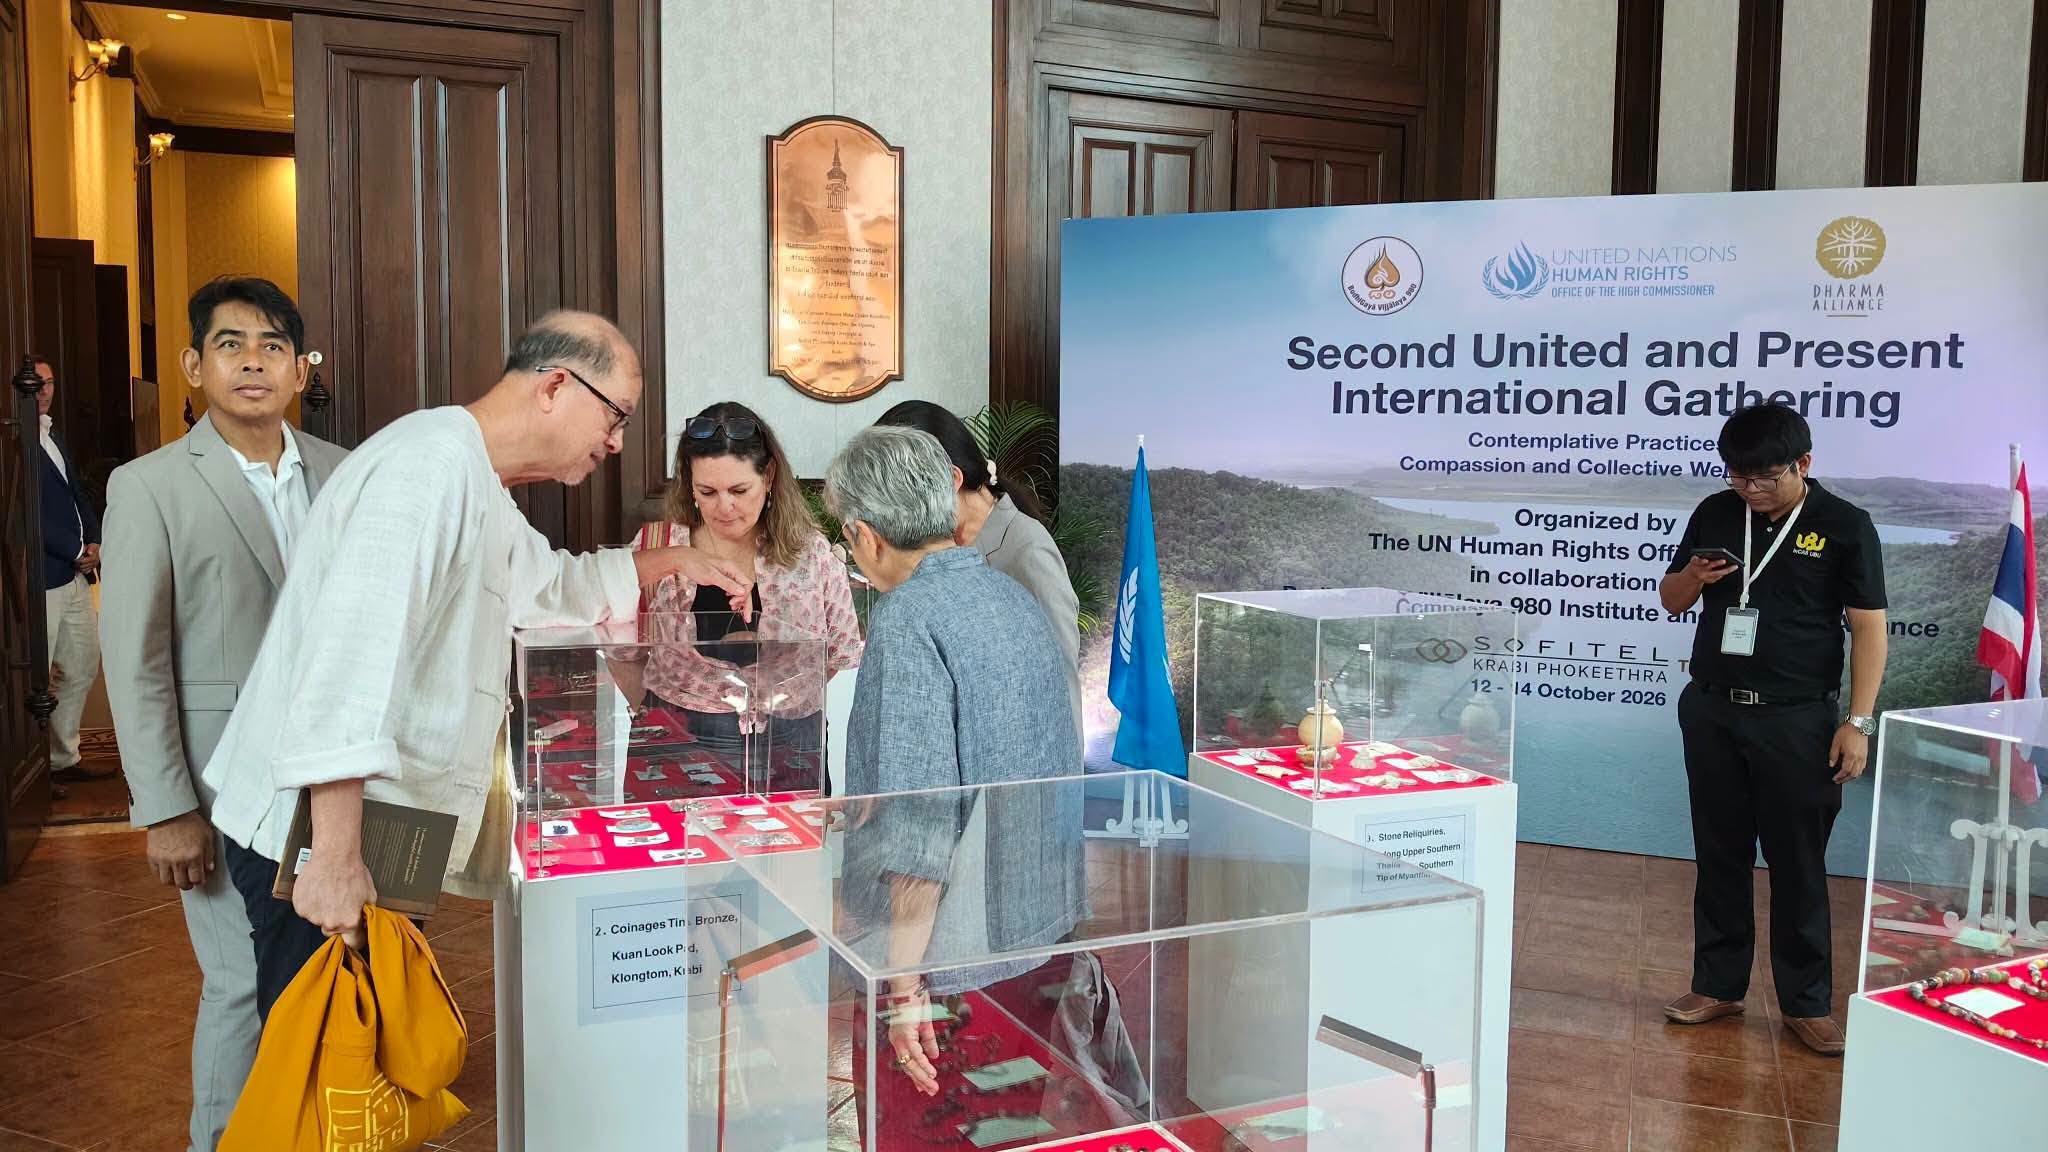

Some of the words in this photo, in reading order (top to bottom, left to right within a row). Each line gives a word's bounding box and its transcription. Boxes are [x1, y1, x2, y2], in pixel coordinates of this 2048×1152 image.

[1553, 248, 1630, 265] UNITED
[1638, 246, 1736, 264] NATIONS
[1553, 267, 1617, 282] HUMAN
[1624, 266, 1688, 280] RIGHTS
[1552, 287, 1582, 298] OFFICE
[1585, 287, 1596, 297] OF
[1599, 287, 1615, 296] THE
[1619, 286, 1639, 296] HIGH
[1643, 285, 1714, 296] COMMISSIONER
[1814, 284, 1883, 298] DHARMA
[1813, 299, 1882, 310] ALLIANCE
[1287, 334, 1455, 370] Second
[1473, 332, 1628, 368] United
[1646, 332, 1738, 368] and
[1758, 332, 1964, 368] Present
[1333, 380, 1626, 415] International
[1469, 432, 1618, 452] Contemplative
[1626, 434, 1719, 452] Practice
[1400, 456, 1525, 475] Compassion
[1532, 459, 1570, 474] and
[1578, 459, 1682, 478] Collective
[1515, 509, 1638, 531] Organized
[1648, 513, 1677, 535] by
[1368, 533, 1409, 550] The
[1418, 535, 1451, 552] UN
[1461, 536, 1543, 556] Human
[1552, 540, 1629, 562] Rights
[1637, 542, 1682, 562] Off
[1471, 566, 1489, 583] in
[1498, 568, 1656, 591] collaboration
[1508, 596, 1553, 616] 980
[1560, 599, 1659, 621] Institute
[1474, 636, 1669, 662] SOFITEL
[1472, 657, 1529, 674] KRABI
[1538, 661, 1668, 684] PHOKEETHRA
[1470, 677, 1492, 694] 12
[1513, 681, 1533, 697] 14
[1538, 683, 1615, 702] October
[1621, 690, 1666, 706] 2026
[1378, 832, 1402, 843] Stone
[1402, 848, 1425, 858] Upper
[1427, 843, 1461, 854] Southern
[1418, 860, 1454, 870] Southern
[1376, 874, 1388, 883] Tip
[1389, 873, 1397, 881] of
[594, 926, 607, 938] 2.
[610, 921, 666, 936] Coinages
[695, 914, 738, 926] Bronze,
[612, 949, 644, 962] Kuan
[644, 944, 674, 959] Look
[611, 970, 672, 984] Klongtom,
